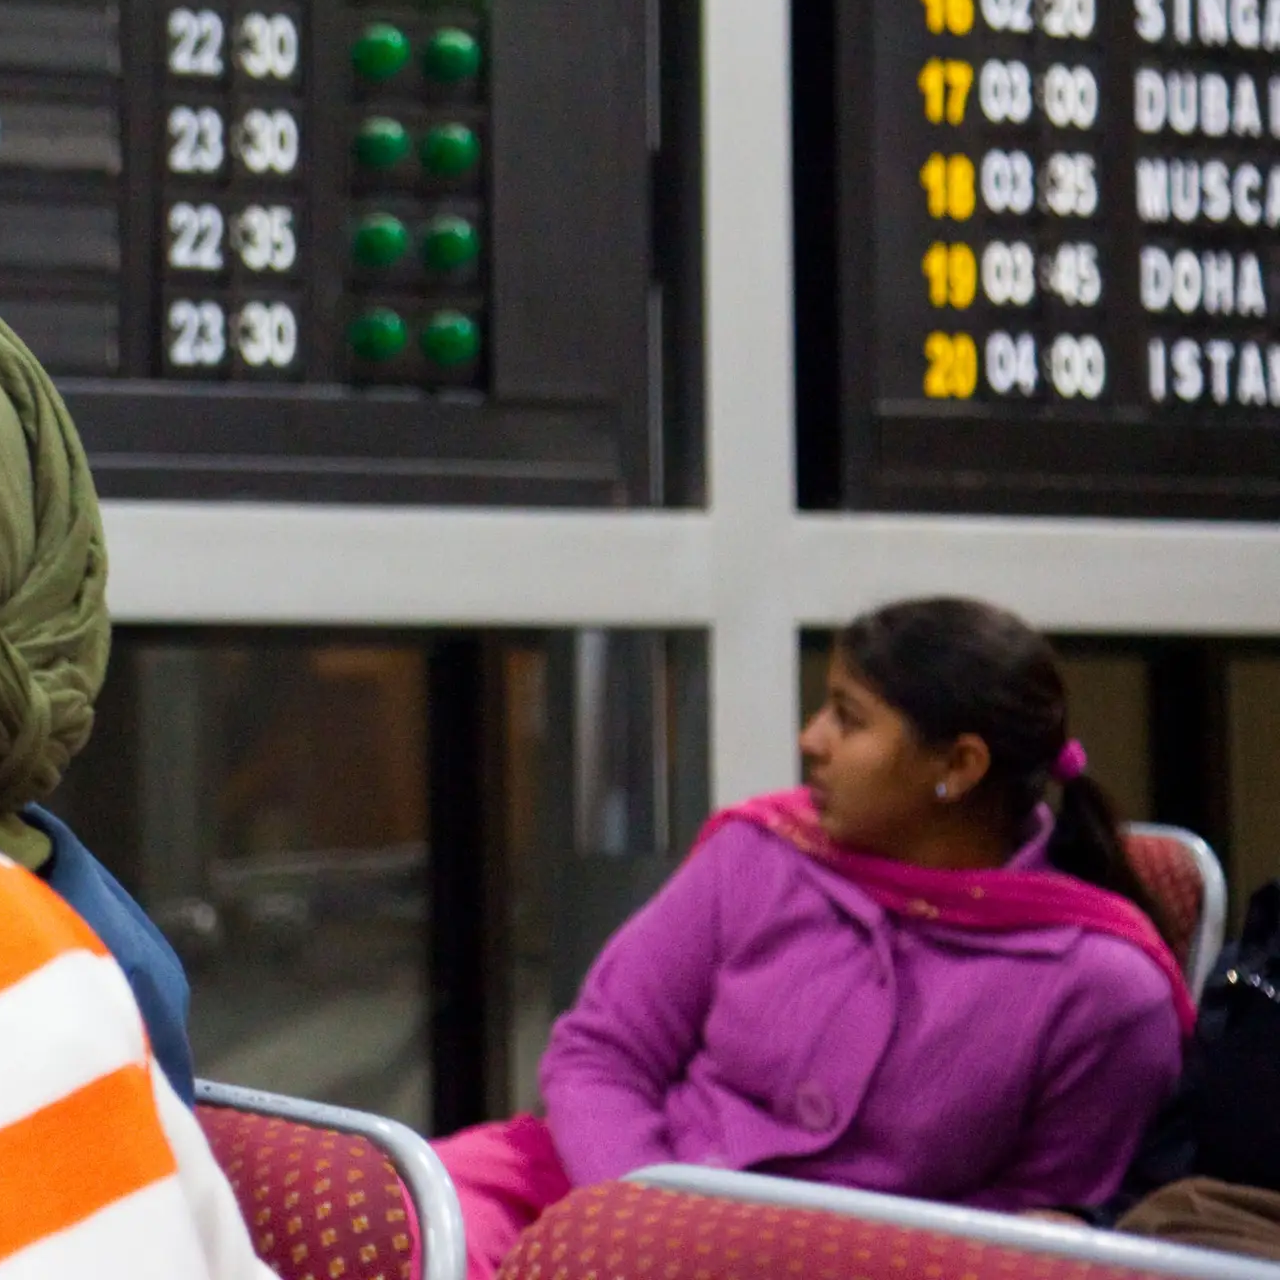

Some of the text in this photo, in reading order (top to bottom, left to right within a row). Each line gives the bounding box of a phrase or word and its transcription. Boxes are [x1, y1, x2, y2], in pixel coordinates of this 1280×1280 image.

[170, 10, 223, 74] 22
[920, 62, 972, 122] 17
[171, 108, 223, 171] 23
[923, 156, 974, 218] 18
[171, 205, 222, 268] 22
[1141, 248, 1265, 313] DOHA
[171, 302, 224, 363] 23
[926, 334, 976, 397] 20
